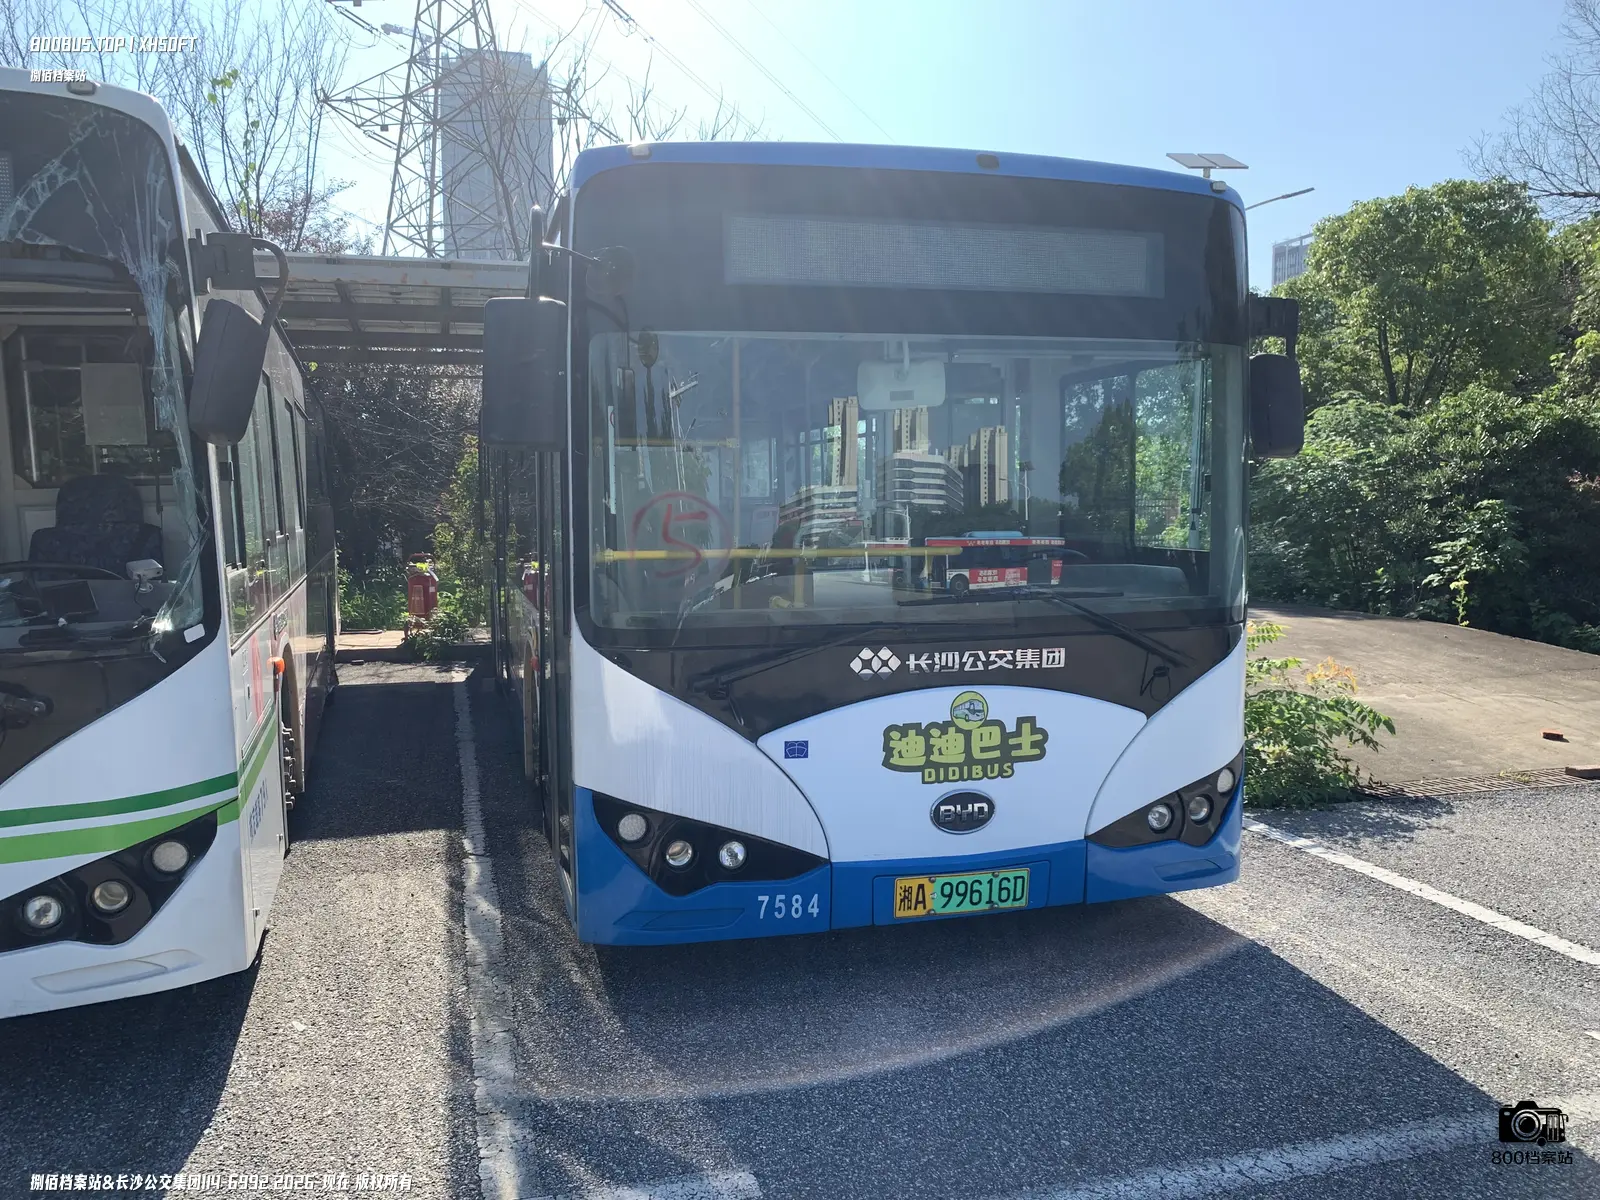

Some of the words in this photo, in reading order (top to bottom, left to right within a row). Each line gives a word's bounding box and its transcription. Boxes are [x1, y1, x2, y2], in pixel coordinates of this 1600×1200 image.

[906, 647, 1066, 674] 长沙公交集团
[889, 722, 1043, 766] 迪迪巴士
[924, 762, 1013, 783] DIDIBUS
[939, 803, 989, 824] BYD
[940, 876, 1026, 908] 99616D
[757, 893, 820, 919] 7584
